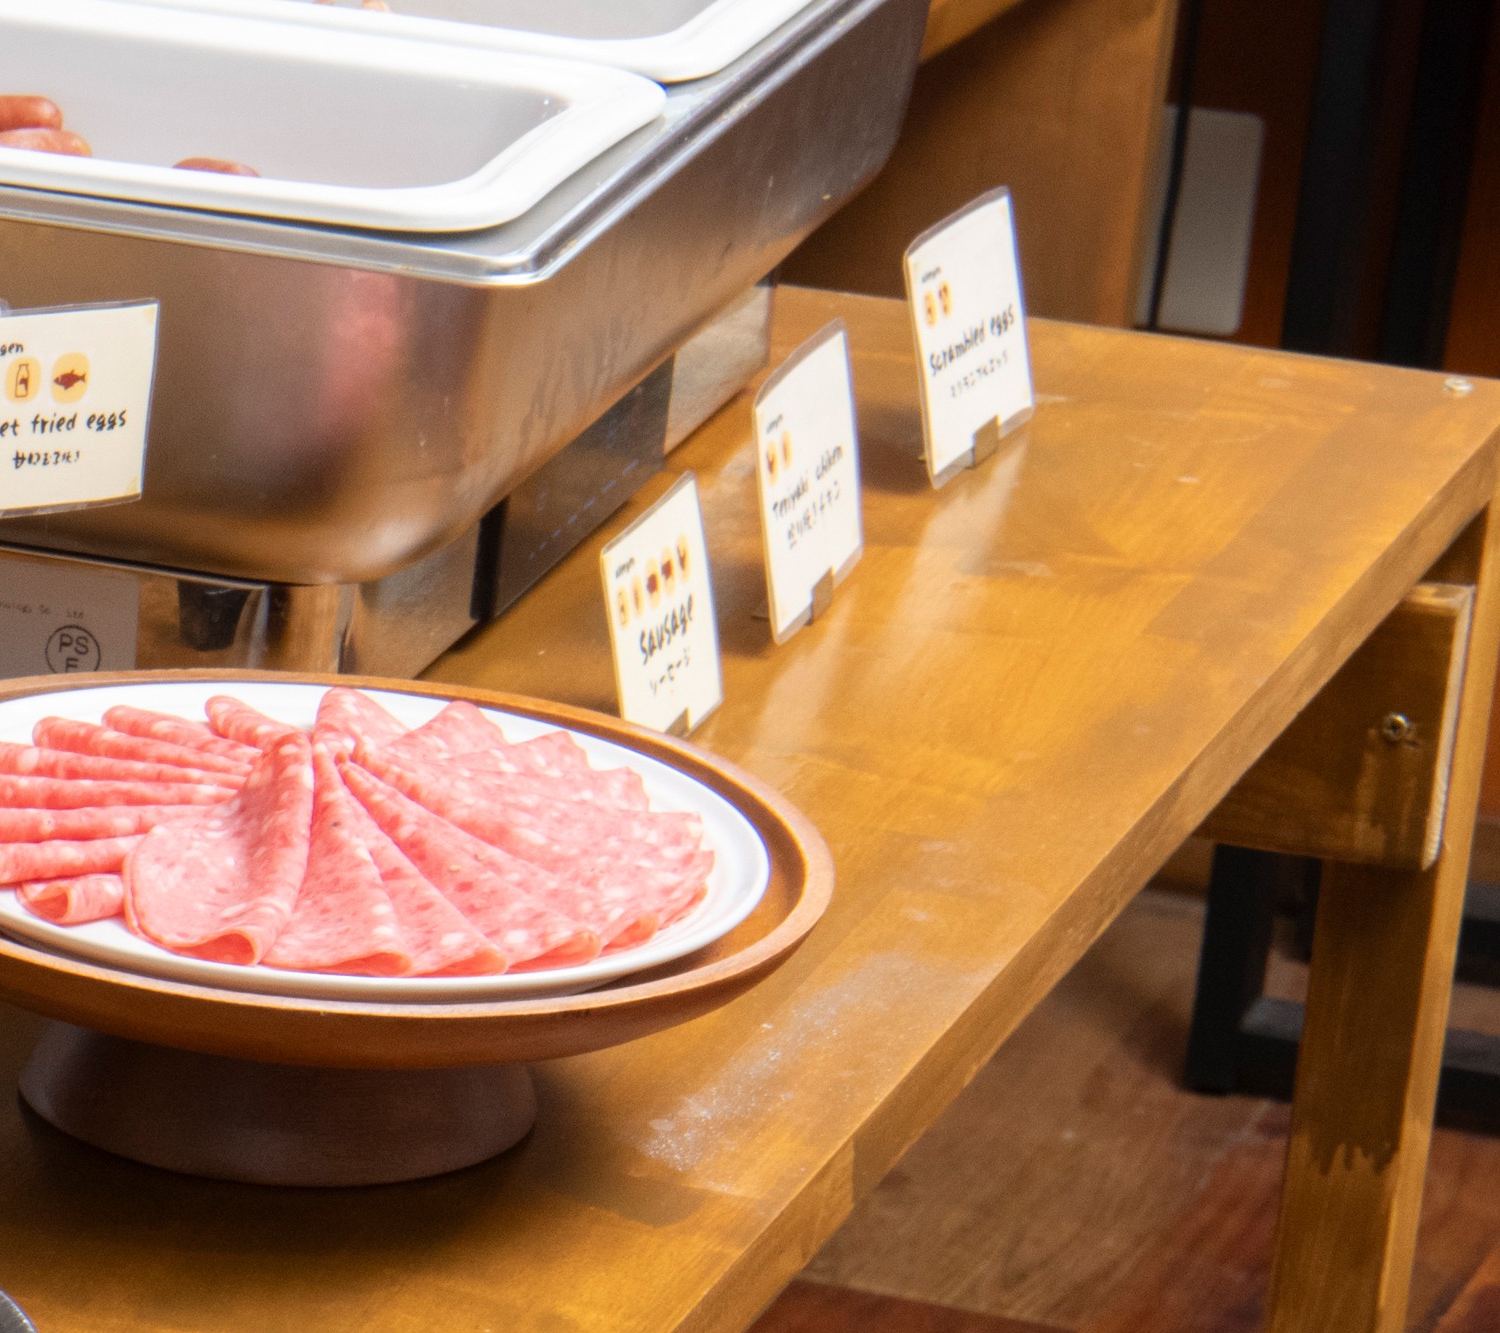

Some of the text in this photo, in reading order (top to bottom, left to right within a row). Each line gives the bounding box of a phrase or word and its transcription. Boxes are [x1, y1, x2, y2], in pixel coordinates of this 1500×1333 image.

[989, 303, 1015, 336] eggs
[31, 411, 78, 434] fried
[86, 409, 128, 432] eggs
[638, 593, 694, 667] Sausage
